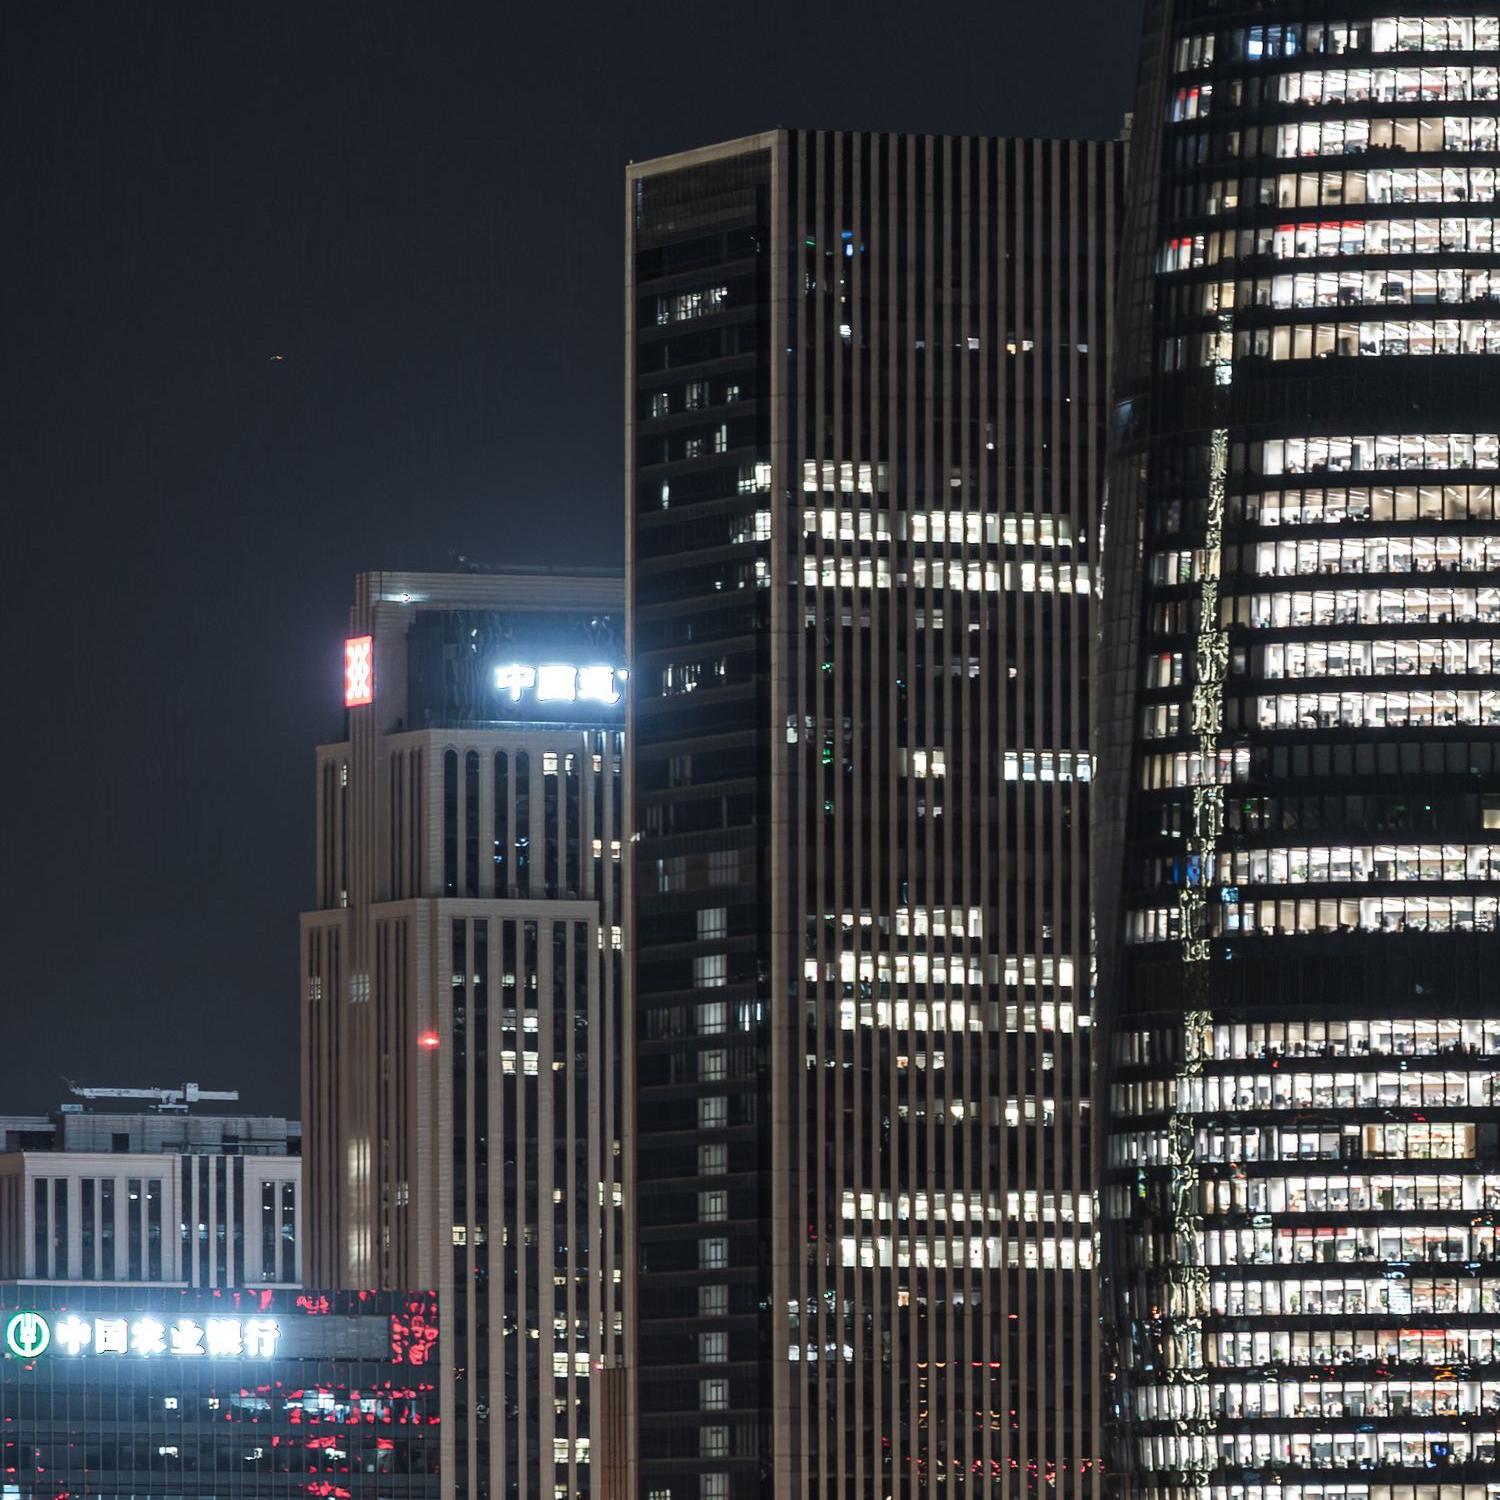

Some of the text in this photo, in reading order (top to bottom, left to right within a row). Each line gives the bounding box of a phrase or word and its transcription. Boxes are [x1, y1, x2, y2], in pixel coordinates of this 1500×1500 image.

[56, 1316, 280, 1356] 中国农业银行
